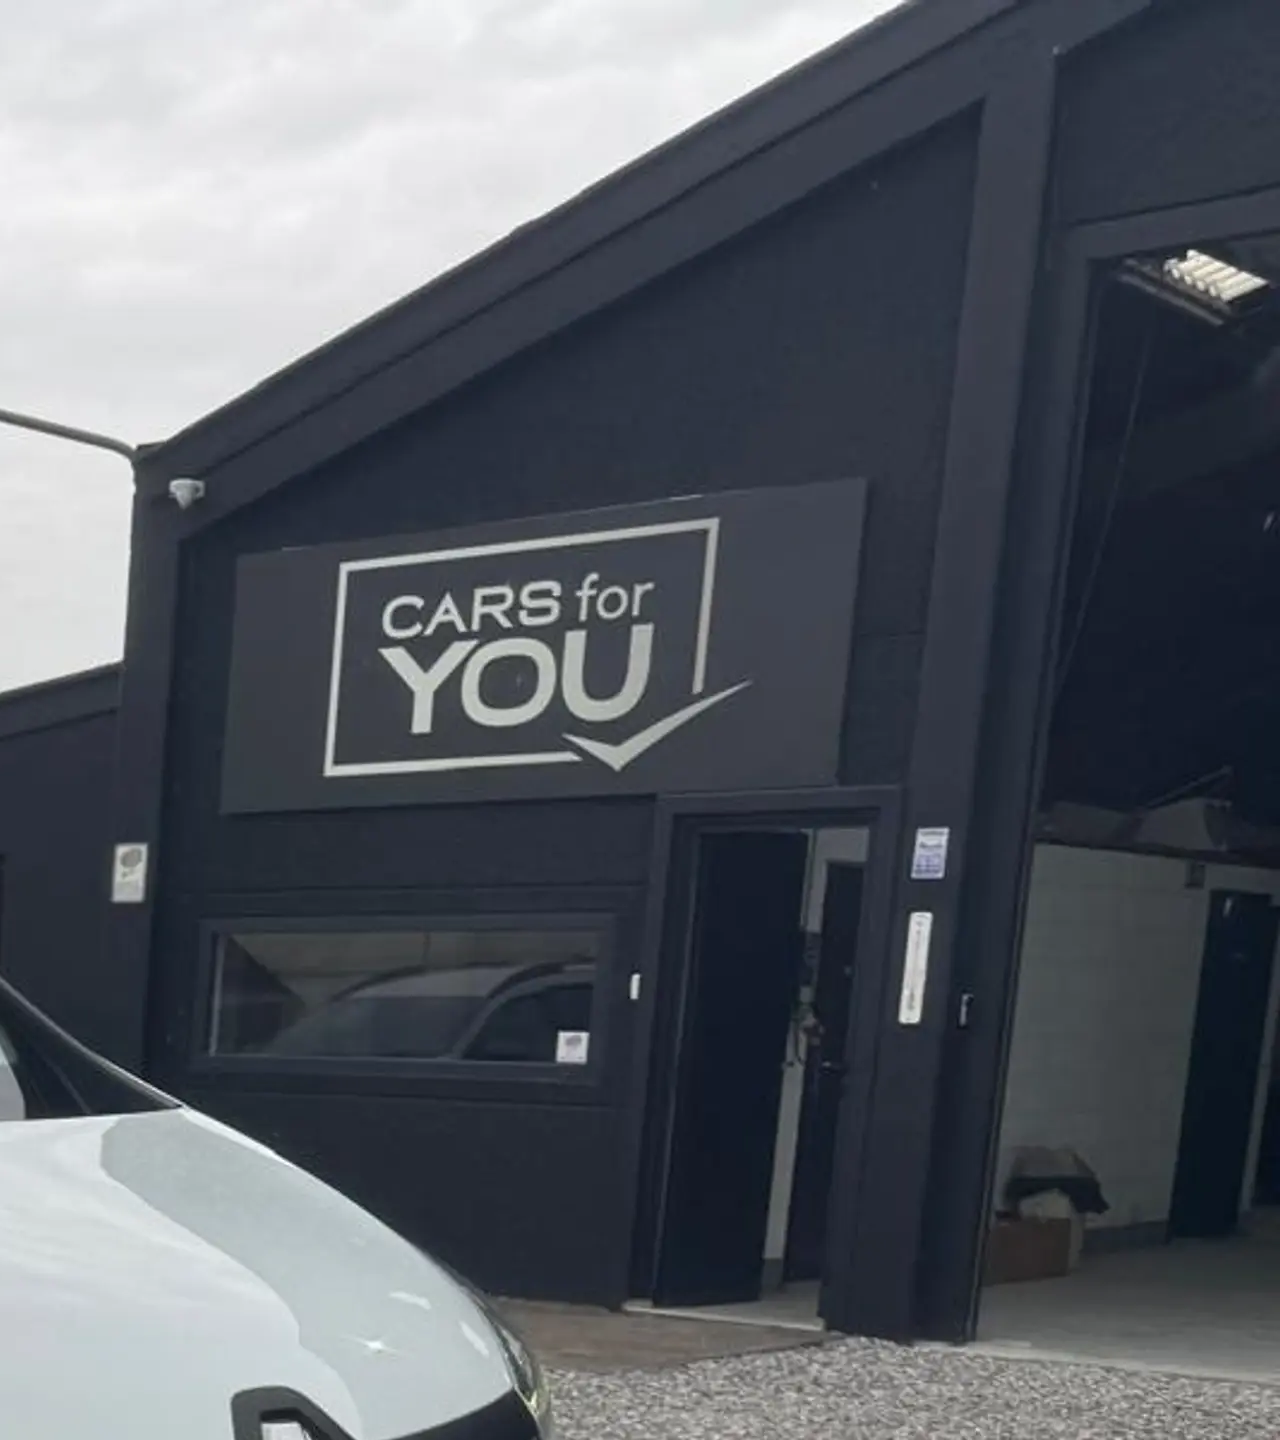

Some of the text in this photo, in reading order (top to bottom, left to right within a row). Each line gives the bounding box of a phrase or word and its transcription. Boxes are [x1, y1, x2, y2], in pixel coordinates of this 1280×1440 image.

[381, 572, 655, 640] CARS for
[377, 622, 655, 735] YOU
